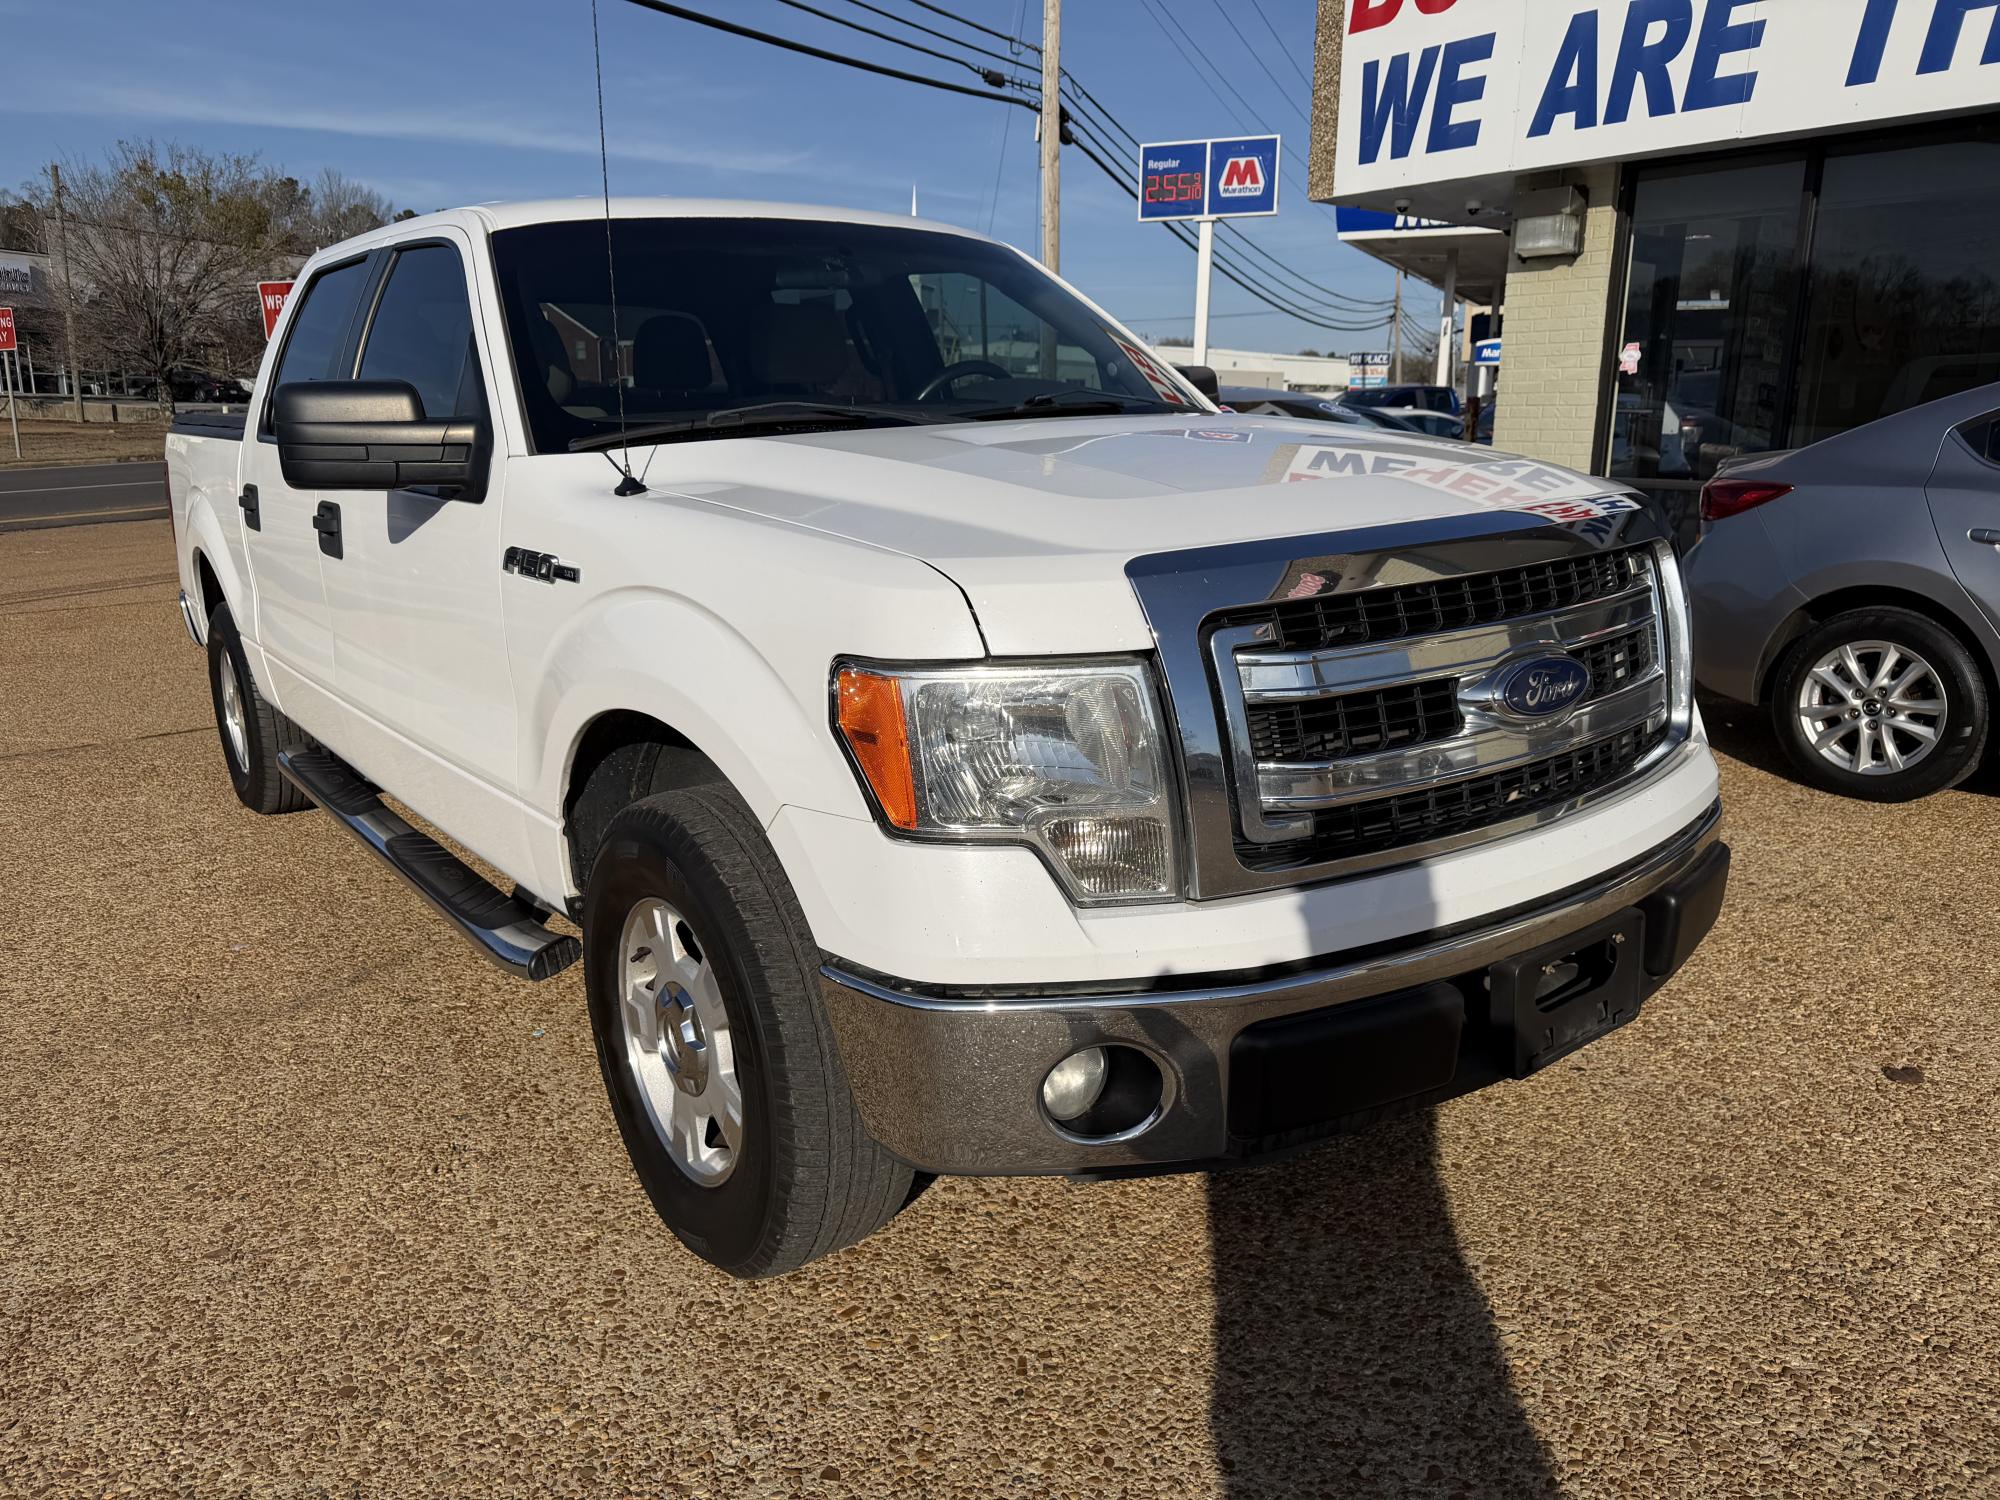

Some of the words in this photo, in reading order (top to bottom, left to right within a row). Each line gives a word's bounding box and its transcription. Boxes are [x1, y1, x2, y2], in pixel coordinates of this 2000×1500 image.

[1358, 31, 1496, 165] WE
[1526, 0, 1767, 138] ARE
[1147, 158, 1180, 170] Regular
[1222, 184, 1262, 195] Marathon
[1526, 667, 1580, 706] Ford
